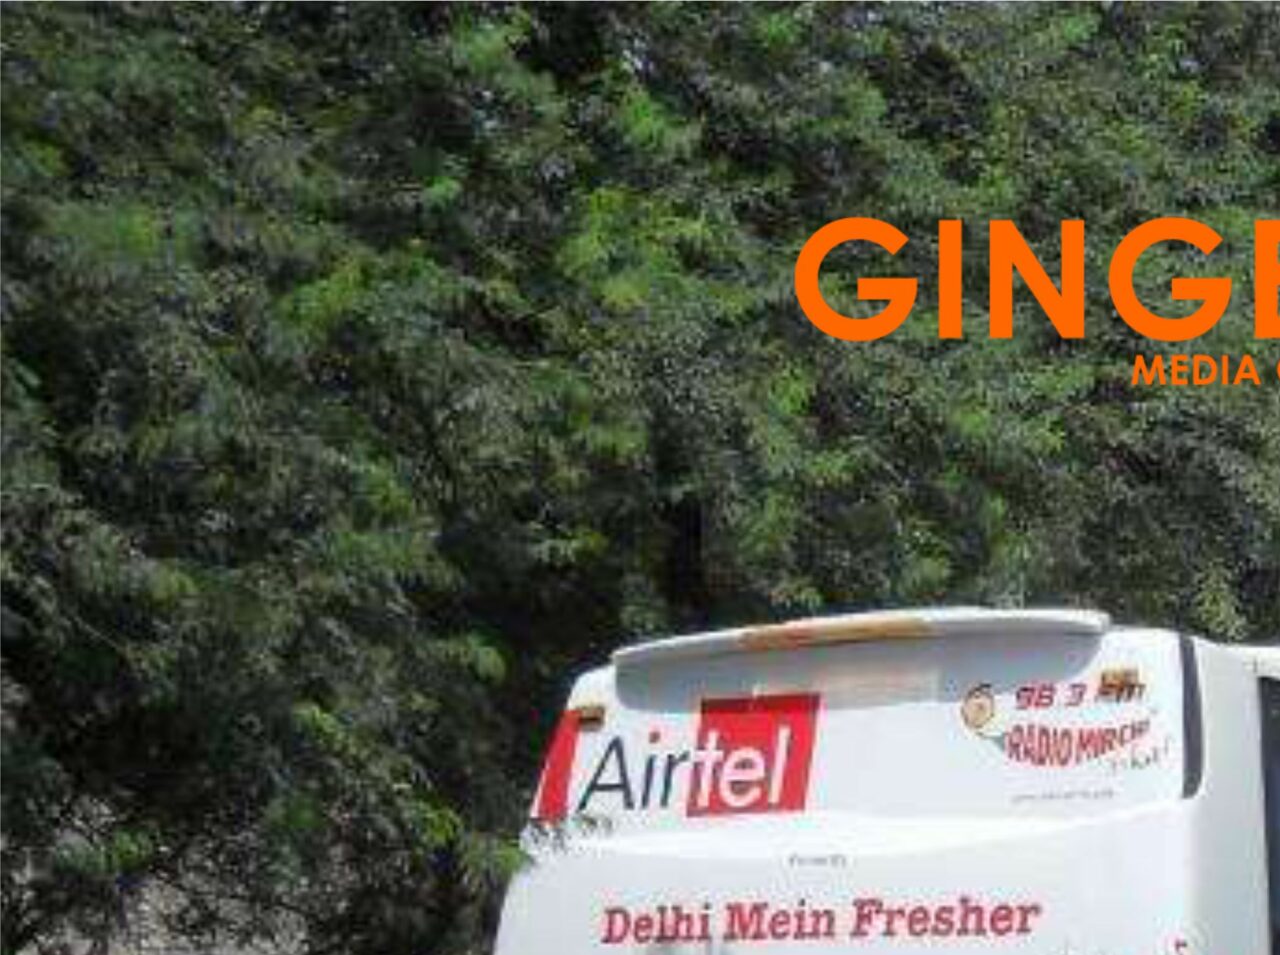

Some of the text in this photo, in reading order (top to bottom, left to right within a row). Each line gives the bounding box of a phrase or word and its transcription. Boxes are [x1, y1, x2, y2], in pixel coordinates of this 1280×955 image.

[577, 724, 792, 812] Airtel
[1004, 723, 1073, 767] RADIO
[601, 896, 1043, 946] Delhi Mein Fresher
